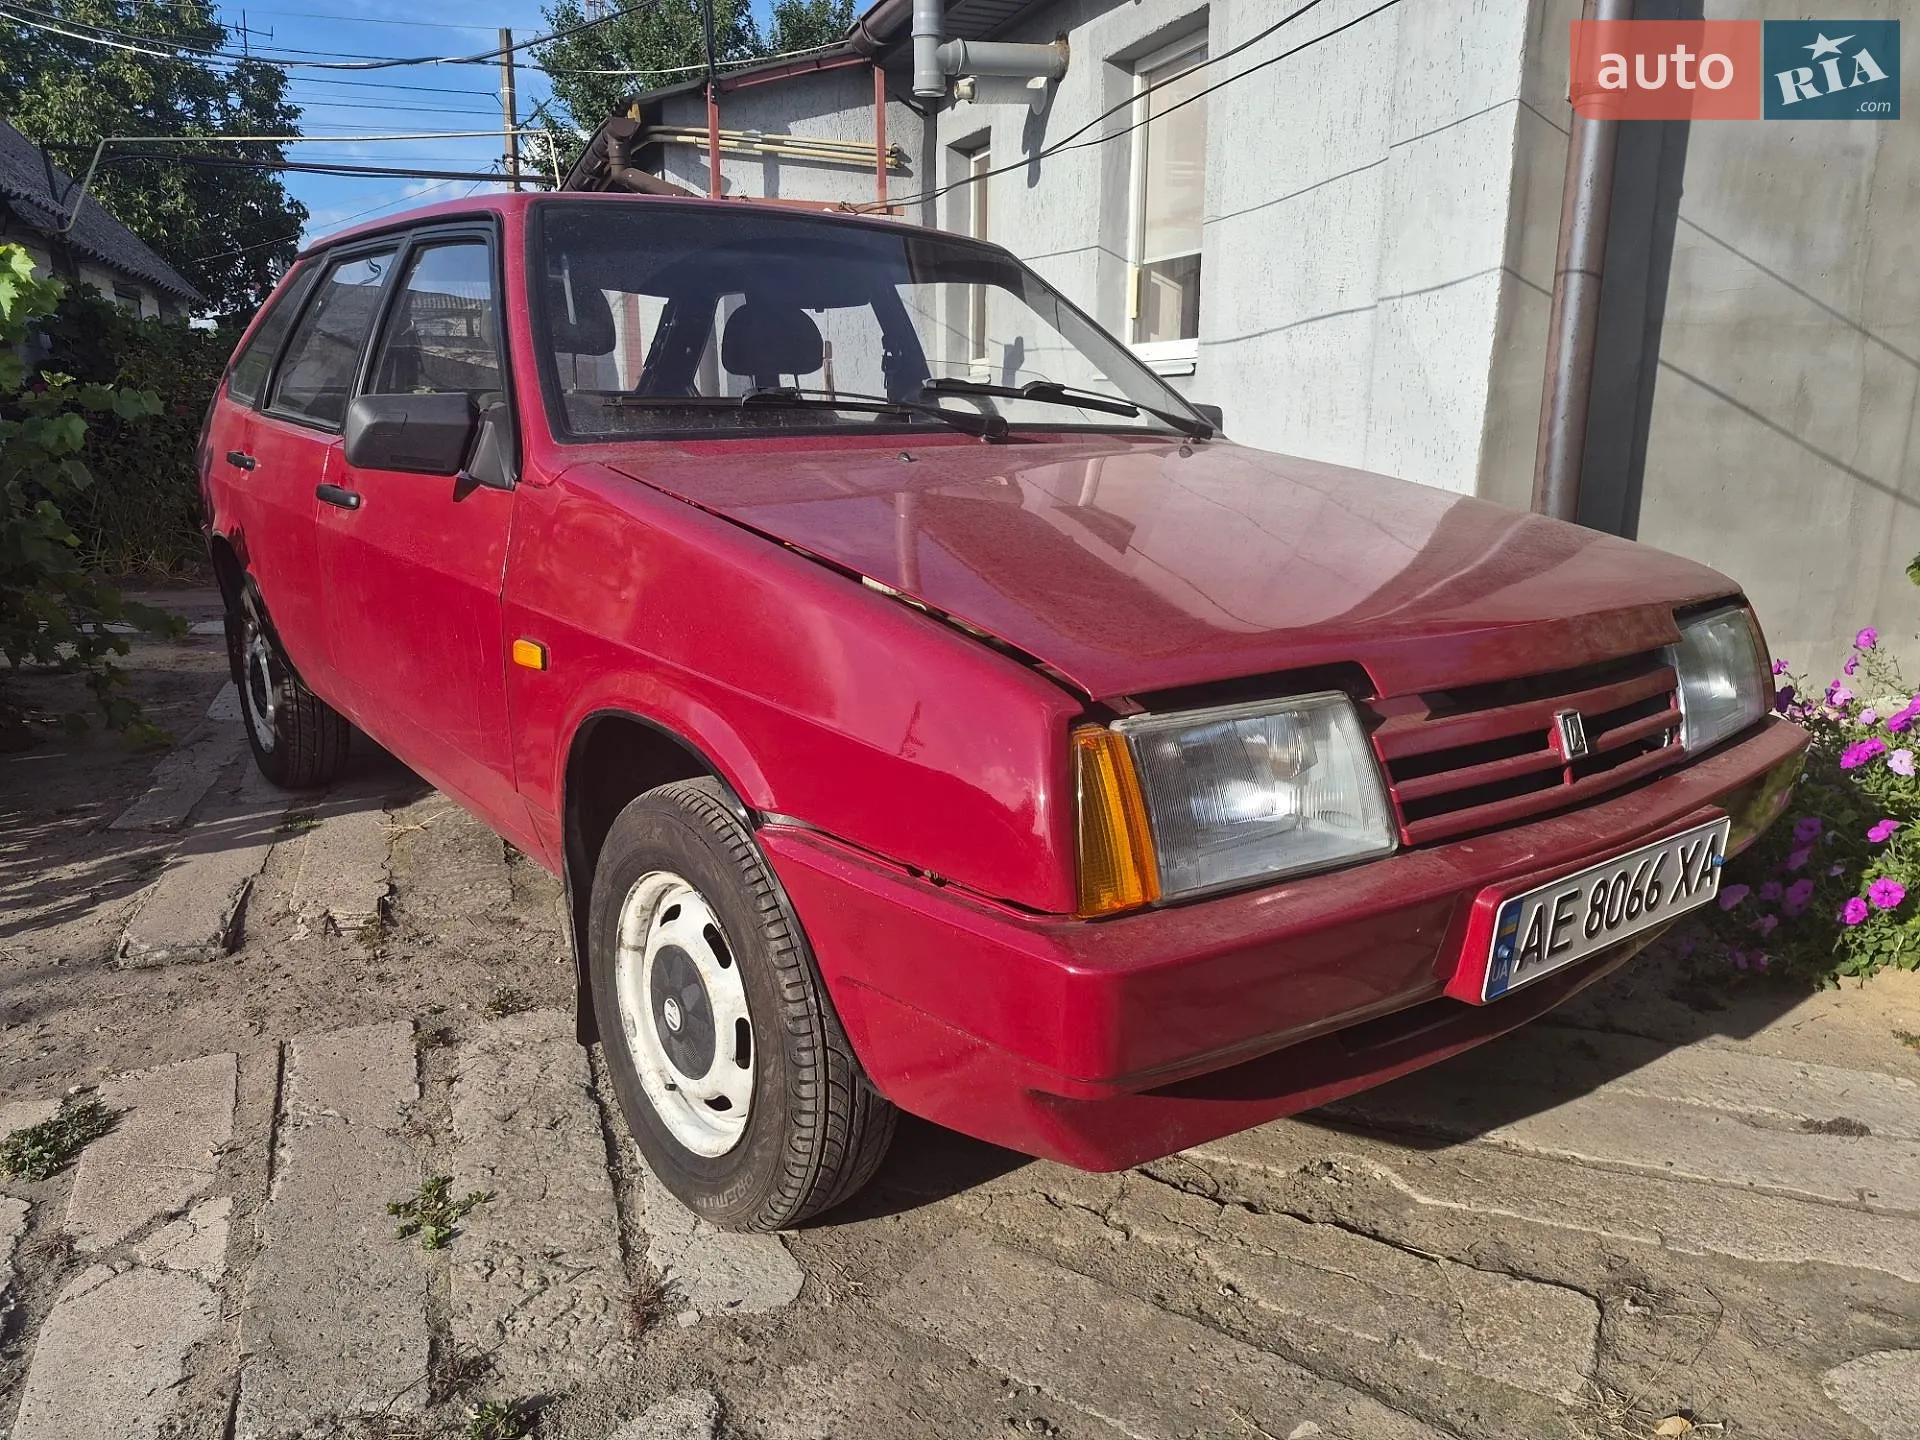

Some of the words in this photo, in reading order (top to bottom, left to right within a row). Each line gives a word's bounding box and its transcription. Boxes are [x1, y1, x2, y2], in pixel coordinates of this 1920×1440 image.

[1513, 886, 1583, 974] AE
[1582, 850, 1668, 941] 8066
[1667, 832, 1717, 905] XA
[1491, 959, 1508, 982] UA
